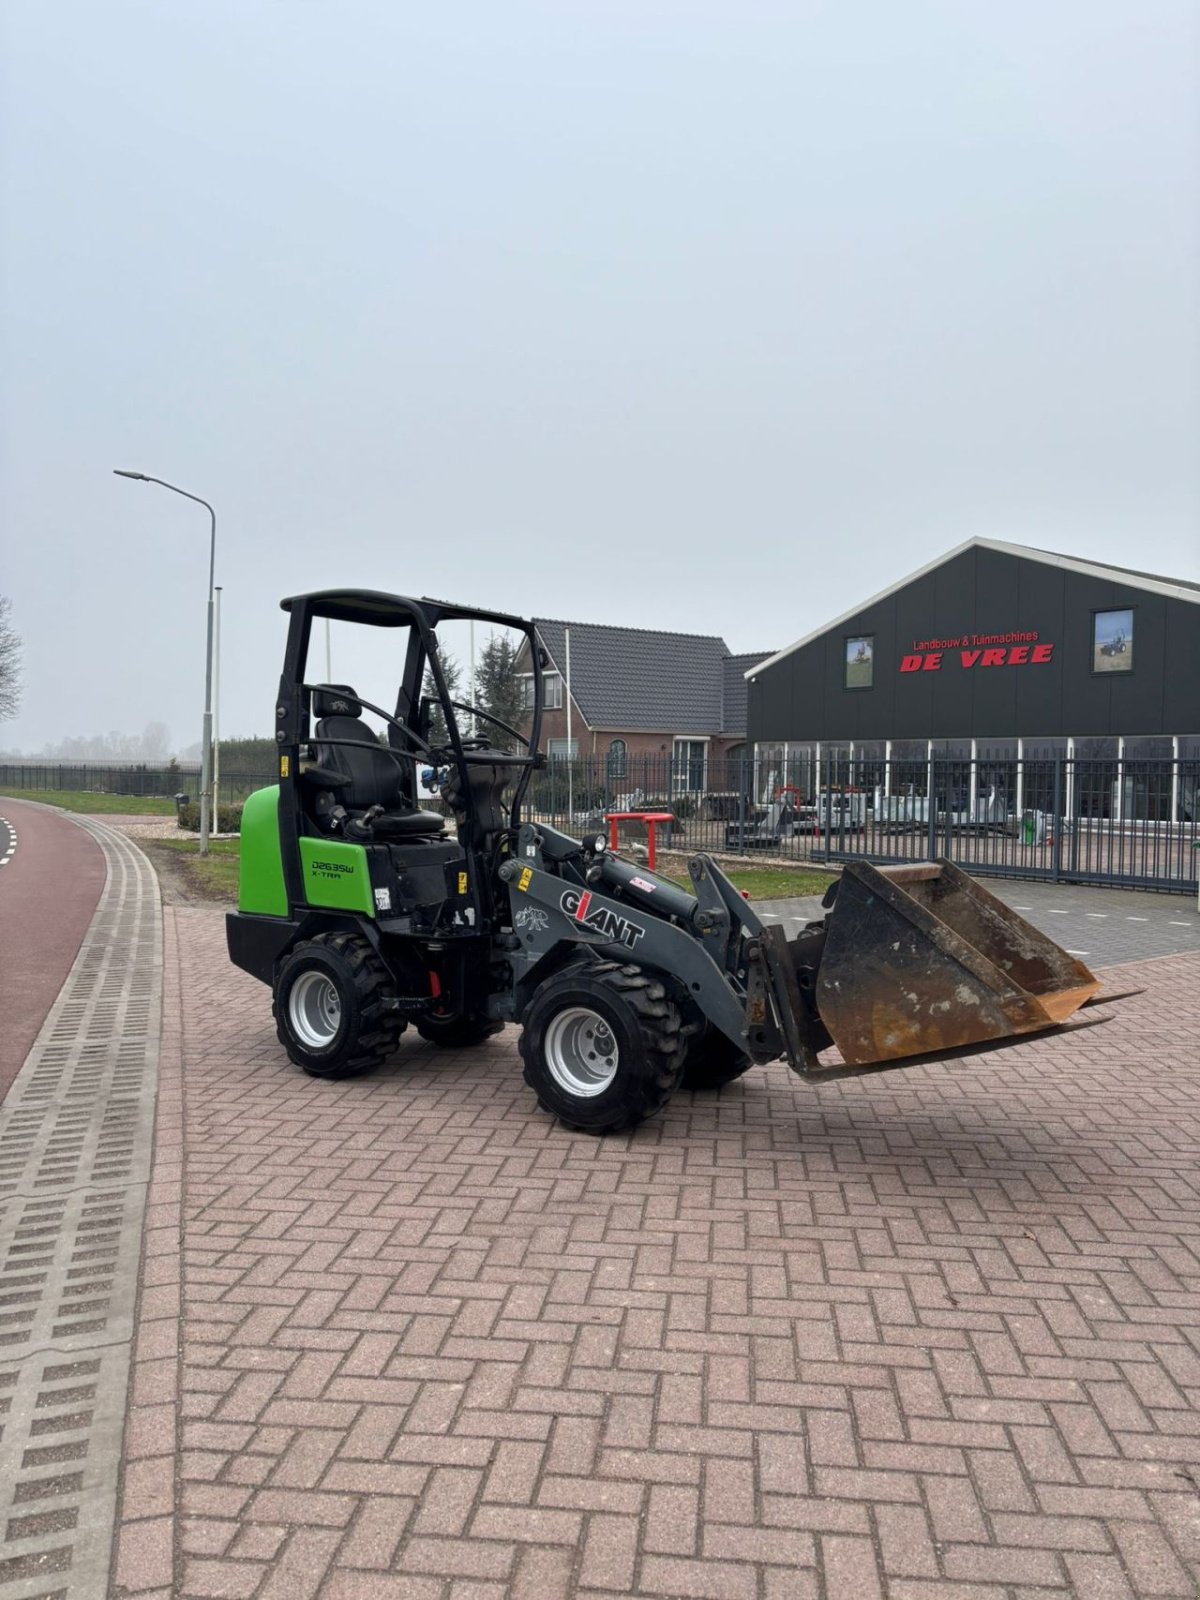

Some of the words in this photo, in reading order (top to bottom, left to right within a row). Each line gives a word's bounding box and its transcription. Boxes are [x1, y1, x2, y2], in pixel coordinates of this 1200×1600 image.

[913, 638, 960, 651] Landbouw
[962, 636, 969, 647] &
[972, 631, 1038, 646] Tuinmachines
[900, 652, 943, 672] DE
[960, 644, 1054, 669] VREE
[560, 889, 646, 950] GIANT
